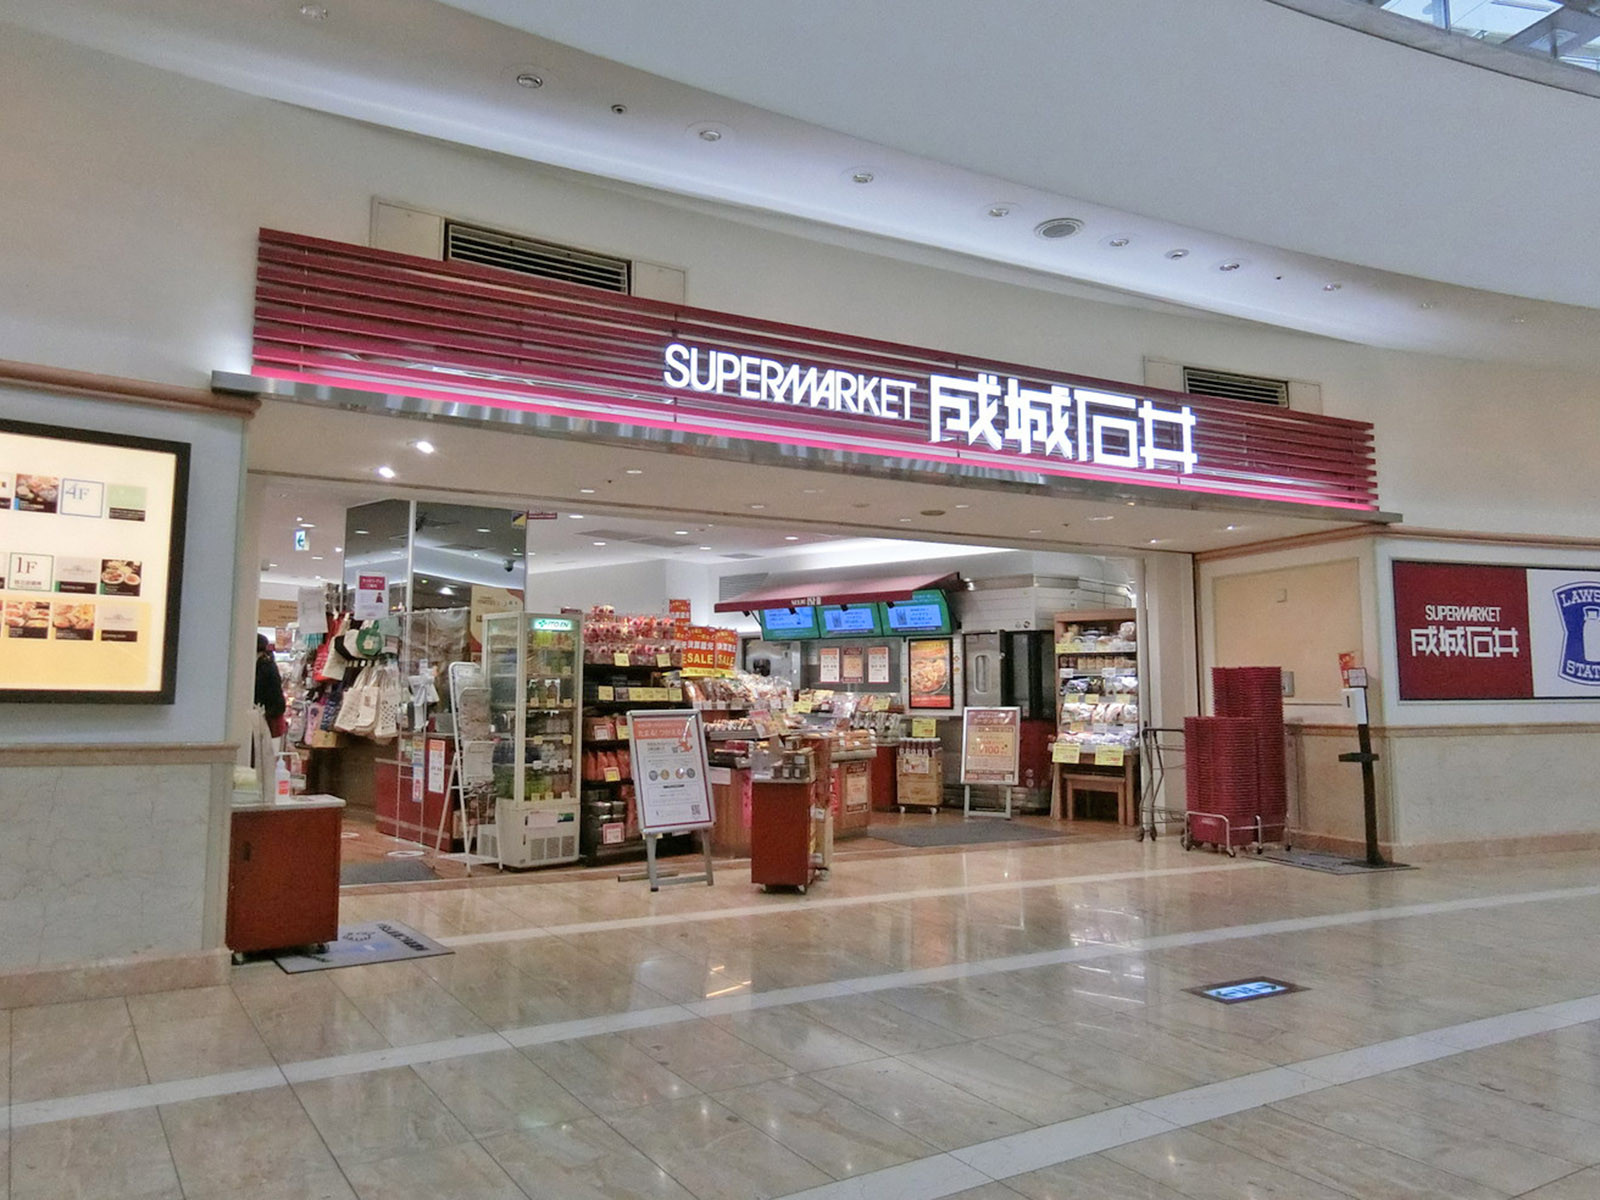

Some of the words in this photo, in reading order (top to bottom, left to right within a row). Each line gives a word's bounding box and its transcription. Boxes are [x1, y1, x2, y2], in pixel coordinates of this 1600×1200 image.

[663, 343, 917, 420] SUPERMARKET
[928, 372, 1199, 475] 成城石井
[65, 483, 90, 501] 4F
[17, 556, 38, 574] 1F
[1425, 604, 1501, 622] SUPERMARKET
[1411, 626, 1519, 658] 成城石井
[686, 652, 714, 665] SALE
[718, 654, 735, 667] SALE
